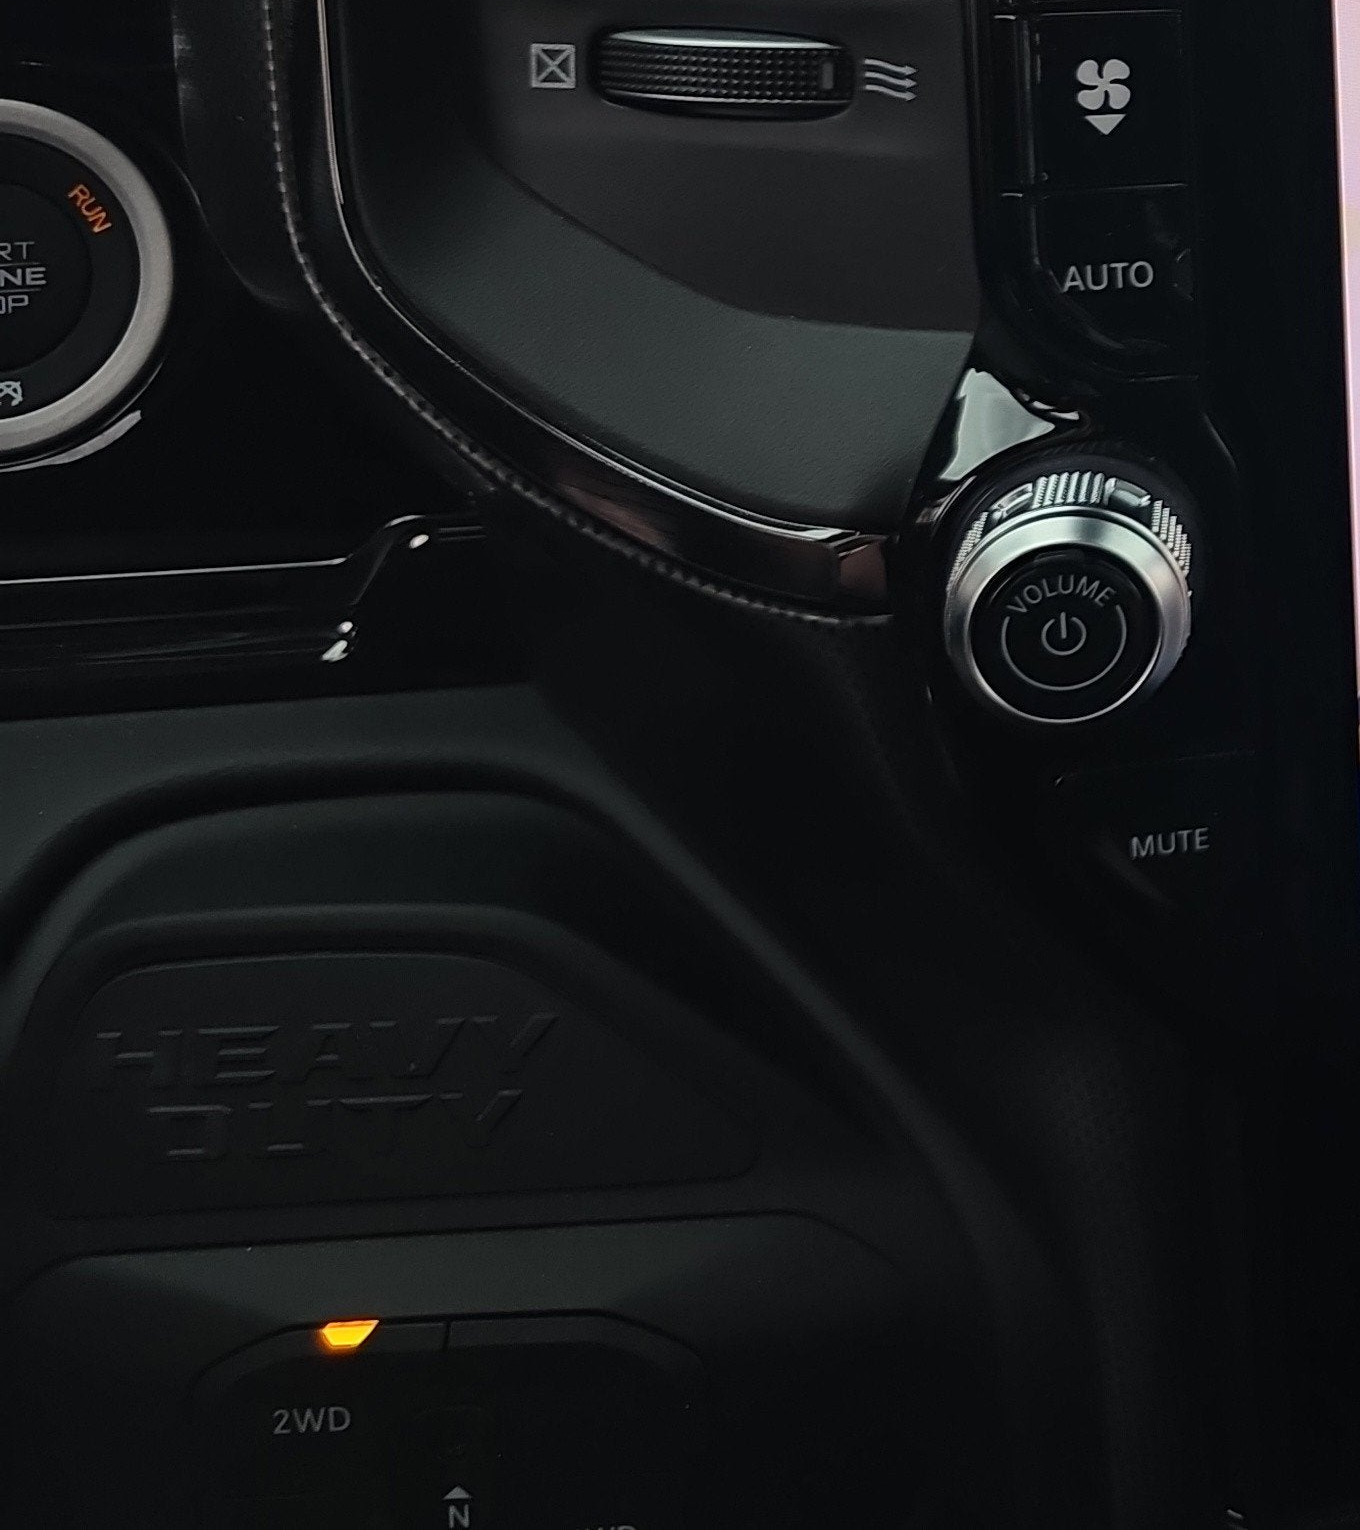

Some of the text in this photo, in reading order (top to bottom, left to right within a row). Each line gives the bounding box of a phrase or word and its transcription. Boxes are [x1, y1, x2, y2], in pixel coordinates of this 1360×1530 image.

[67, 182, 113, 235] RUN
[1062, 260, 1154, 293] AUTO
[1006, 574, 1117, 616] VOLUME
[1129, 827, 1211, 860] MUTE
[271, 1405, 351, 1436] 2WD
